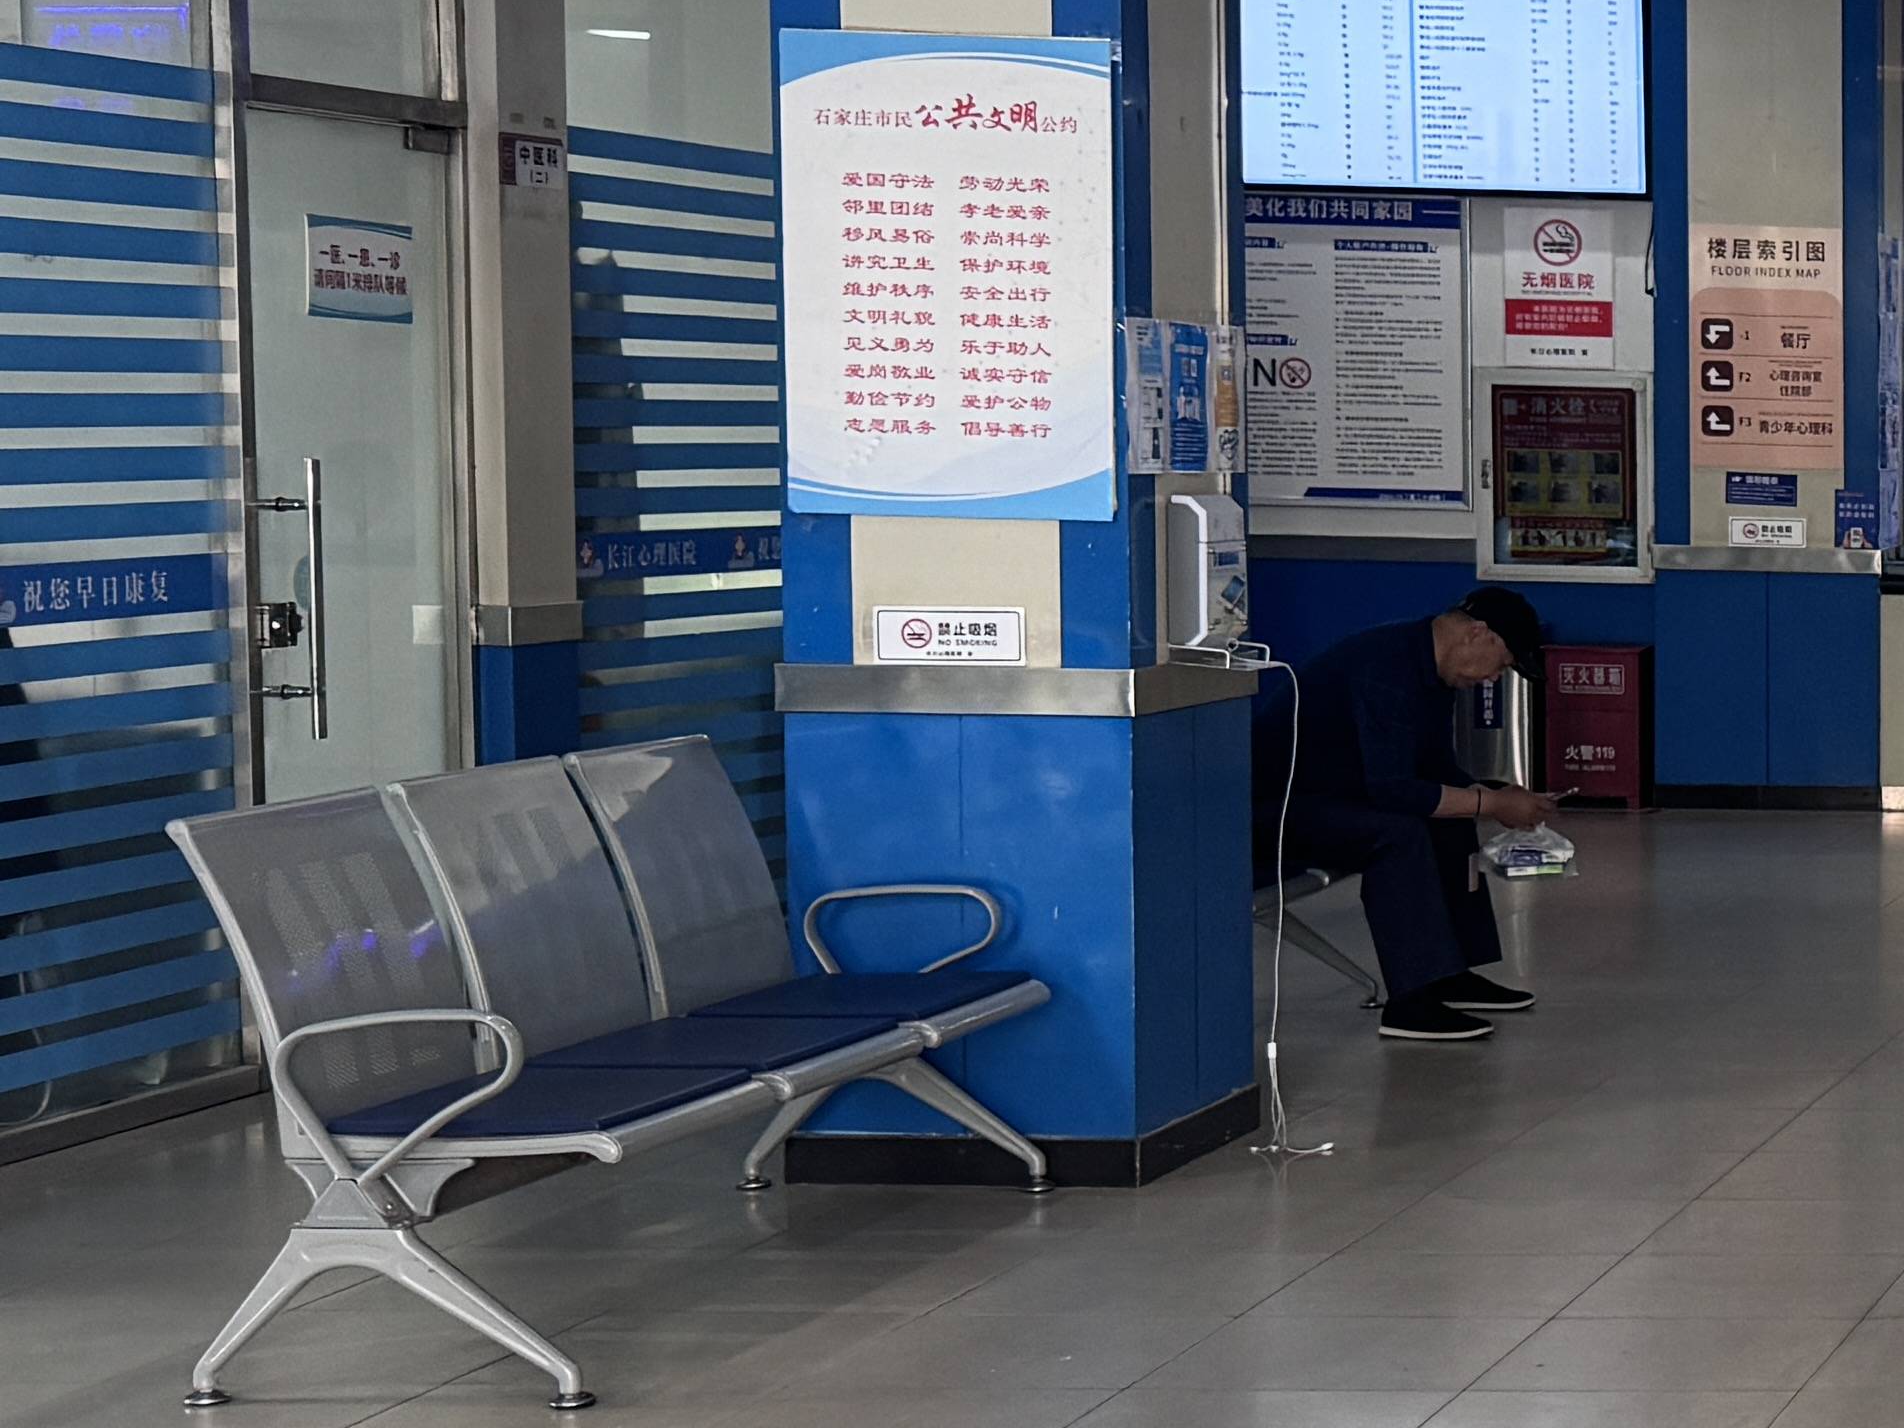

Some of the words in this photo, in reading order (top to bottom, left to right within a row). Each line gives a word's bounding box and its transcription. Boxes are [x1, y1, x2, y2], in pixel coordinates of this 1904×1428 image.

[842, 172, 934, 189] 爱国守法
[959, 175, 1051, 193] 劳动光荣
[842, 199, 934, 217] 邻里团结
[959, 203, 1051, 220] 孝老爱亲
[1246, 197, 1412, 221] 美化我们共同家园
[842, 227, 935, 244] 移风易俗
[960, 230, 1051, 248] 崇尚科学
[1707, 237, 1825, 262] 楼层索引图
[842, 254, 935, 271] 讲究卫生
[960, 258, 1051, 275] 保护环境
[1711, 265, 1751, 277] FLOOR
[1755, 267, 1791, 278] INDEX
[1796, 269, 1820, 279] MAP
[1521, 272, 1595, 290] 无烟医院
[842, 282, 934, 299] 维护秩序
[960, 285, 1051, 302] 安全出行
[843, 309, 936, 326] 文明礼貌
[960, 313, 1052, 329] 健康生活
[844, 337, 935, 353] 见义勇为
[960, 340, 1052, 357] 乐于助人
[1781, 332, 1811, 349] 餐厅
[844, 364, 935, 380] 爱岗敬业
[960, 367, 1052, 384] 诚实守信
[844, 391, 935, 408] 勤俭节约
[960, 395, 1052, 411] 爱护公物
[844, 418, 936, 434] 志愿服务
[961, 421, 1052, 438] 倡导善行
[1760, 420, 1832, 435] 青少年心理科
[24, 570, 169, 613] 祝您早日康复
[938, 622, 997, 637] 禁止吸烟
